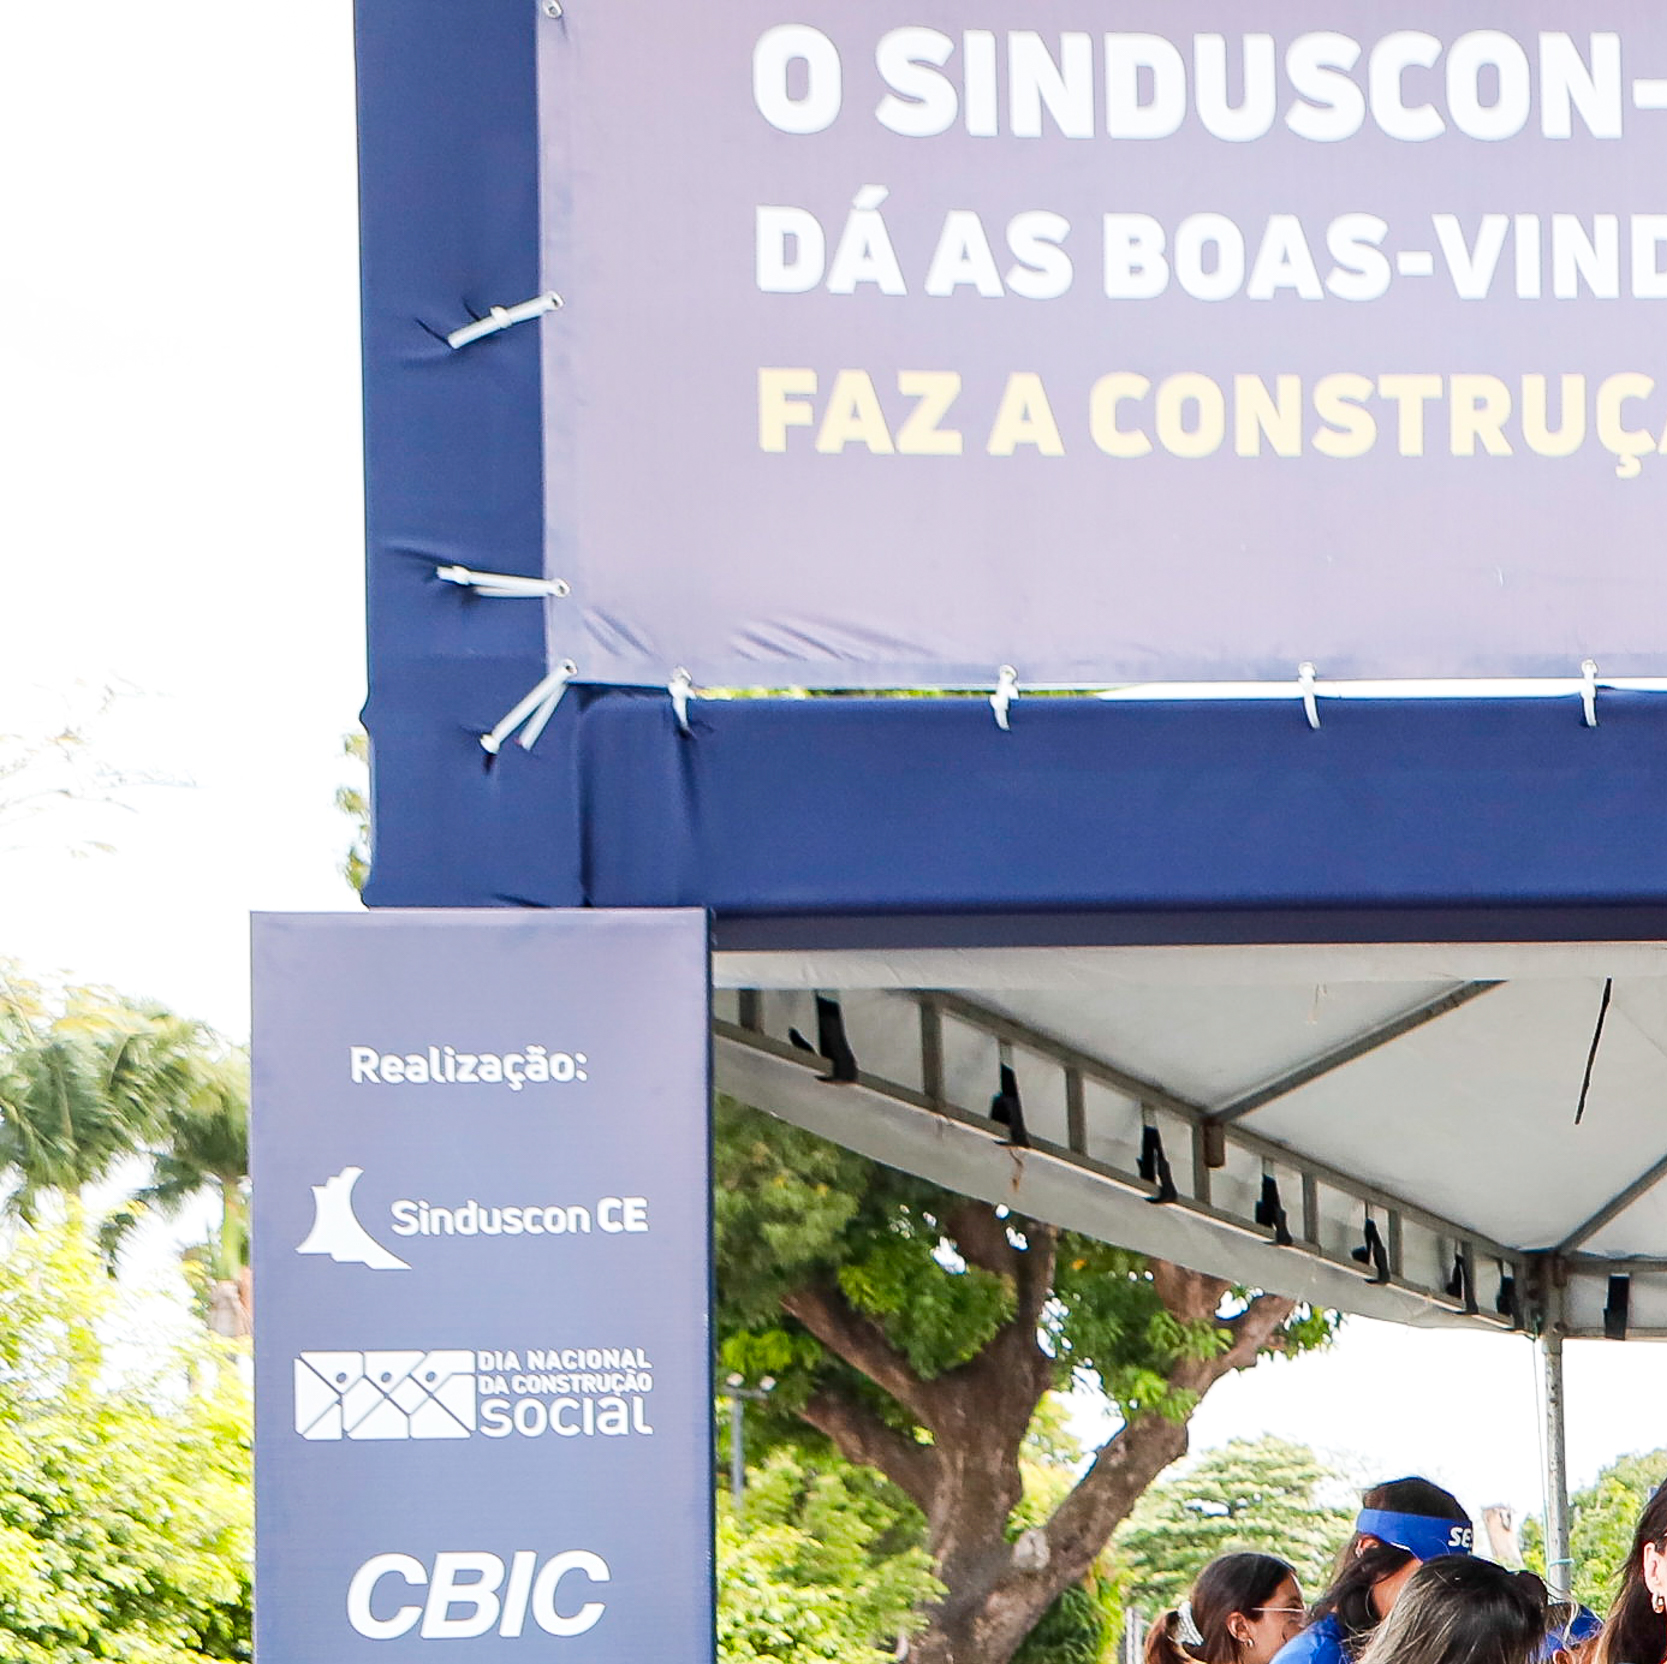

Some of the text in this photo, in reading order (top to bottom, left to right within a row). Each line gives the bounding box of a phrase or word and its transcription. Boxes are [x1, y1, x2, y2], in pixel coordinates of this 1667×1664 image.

[752, 28, 842, 135] O
[754, 185, 907, 298] DÁ
[924, 211, 1074, 298] AS
[755, 366, 965, 456] FAZ
[986, 371, 1066, 456] A
[350, 1045, 589, 1091] Realização:
[390, 1196, 650, 1237] Sinduscon CE
[477, 1347, 654, 1372] DIA NACIONAL
[477, 1368, 654, 1397] DA CONSTRUÇÃO
[1447, 1526, 1472, 1549] SE
[346, 1549, 611, 1641] CBIC
